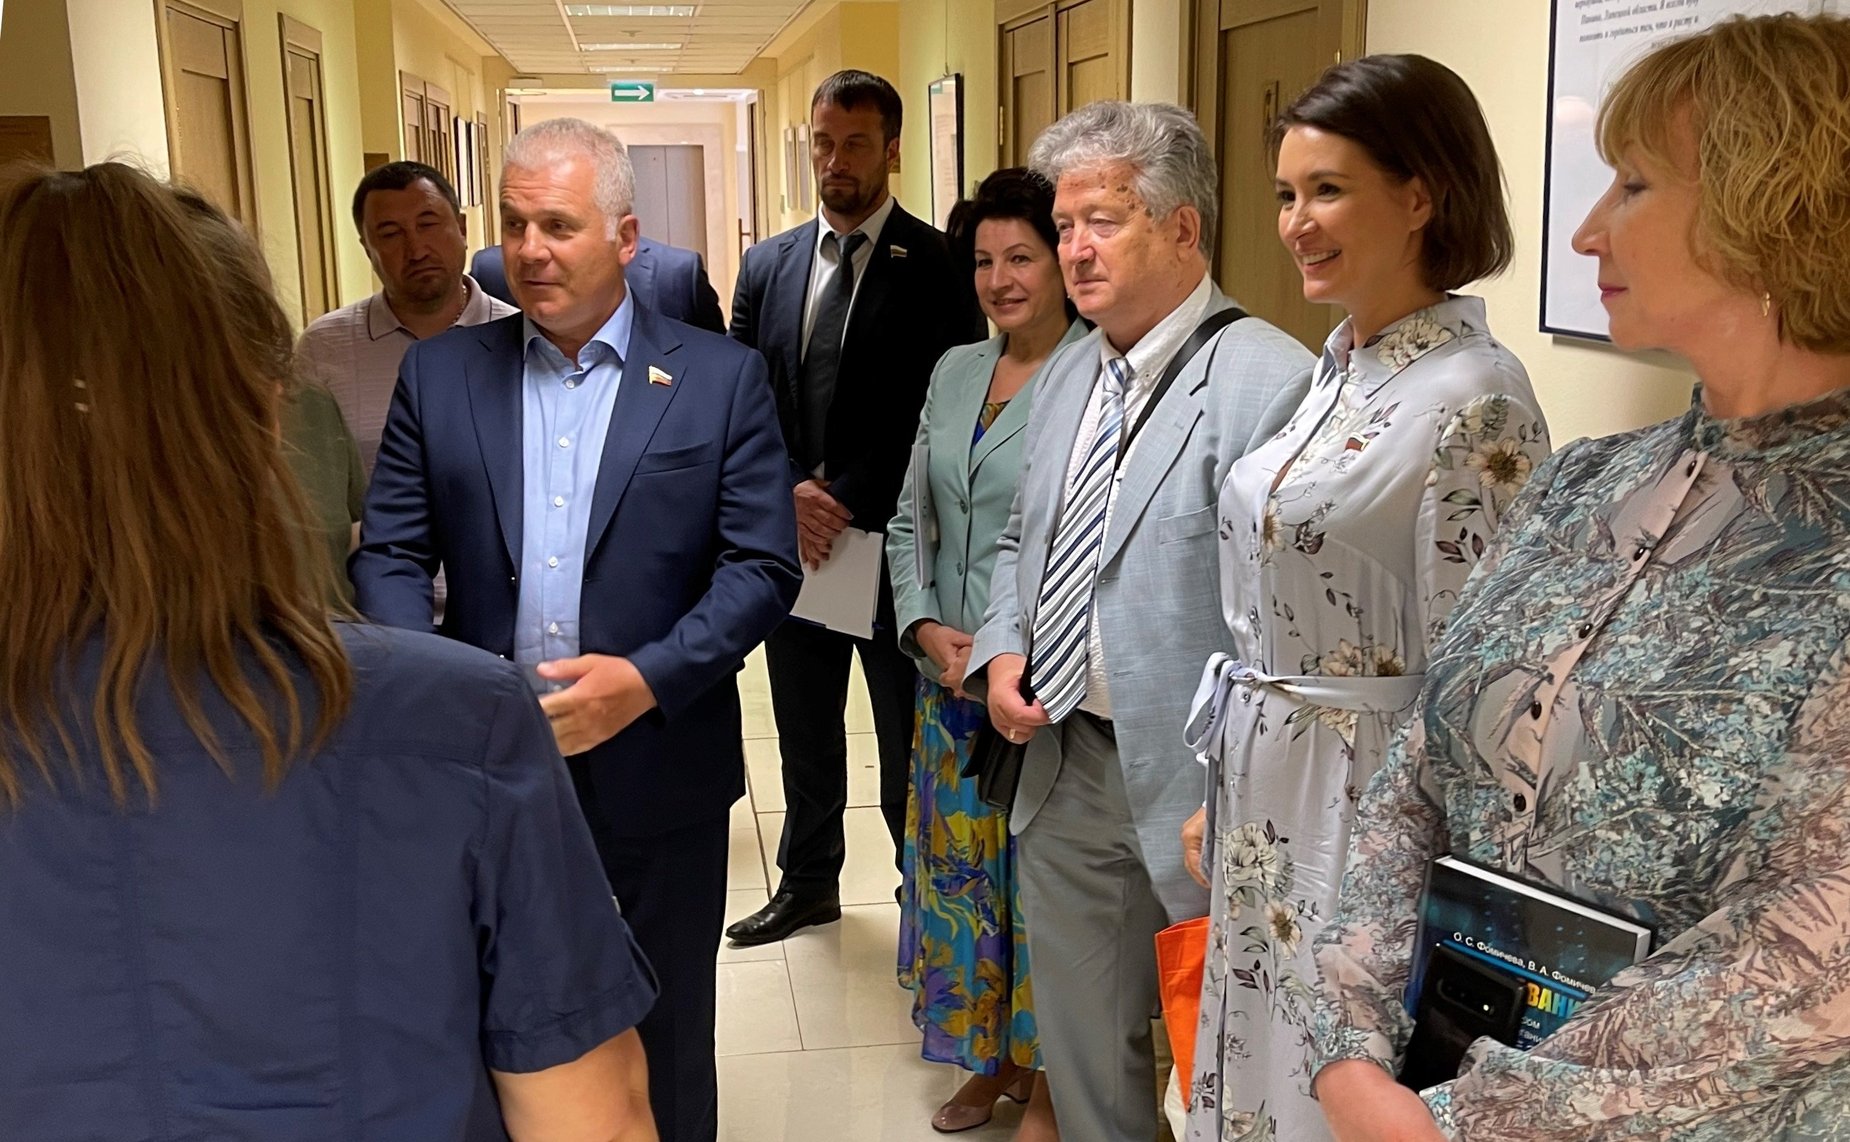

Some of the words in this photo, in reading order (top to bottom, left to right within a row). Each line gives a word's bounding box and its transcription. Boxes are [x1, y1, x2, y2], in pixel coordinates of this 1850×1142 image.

[1465, 936, 1475, 948] С.
[1476, 941, 1525, 968] Фомичева,
[1528, 960, 1537, 972] В.
[1539, 966, 1549, 976] А.
